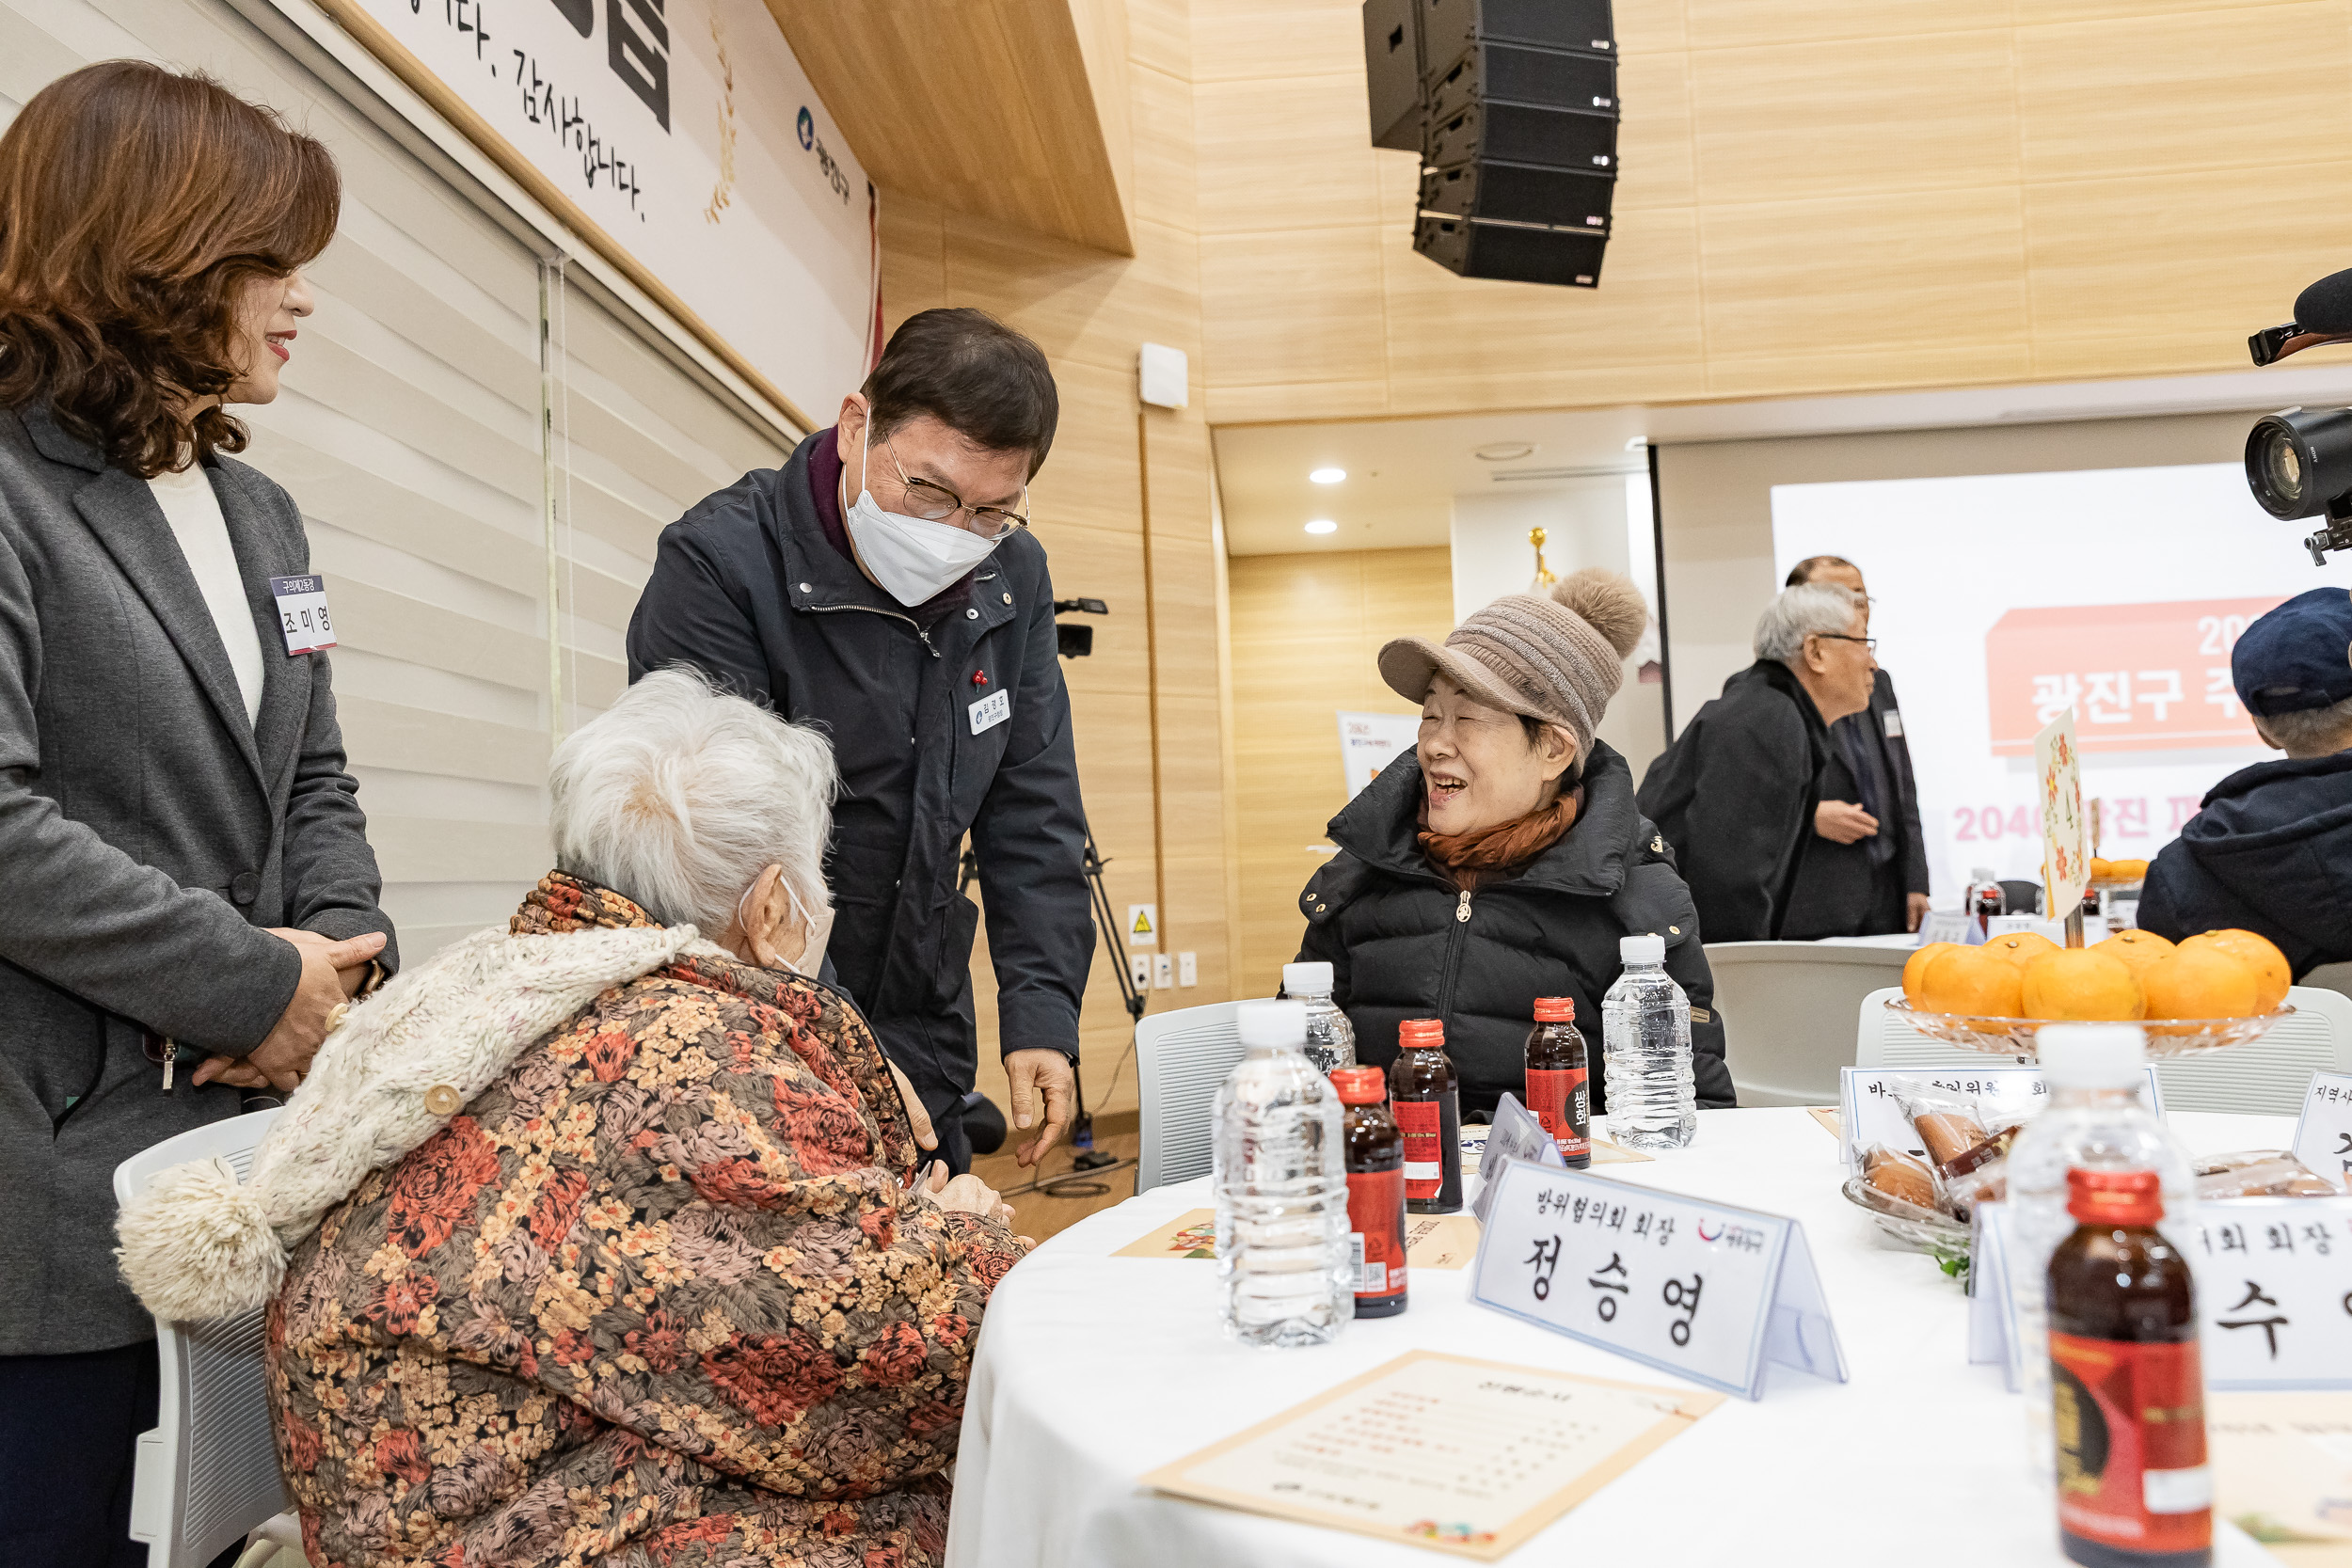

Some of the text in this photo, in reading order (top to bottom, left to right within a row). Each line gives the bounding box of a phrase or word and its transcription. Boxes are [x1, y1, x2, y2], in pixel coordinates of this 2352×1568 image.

[513, 49, 645, 223] 감사합니다.
[2197, 614, 2260, 657] 20
[2031, 669, 2185, 726] 광진구
[1537, 1188, 1676, 1246] 방위협의회 회장
[2265, 1221, 2333, 1257] 회장
